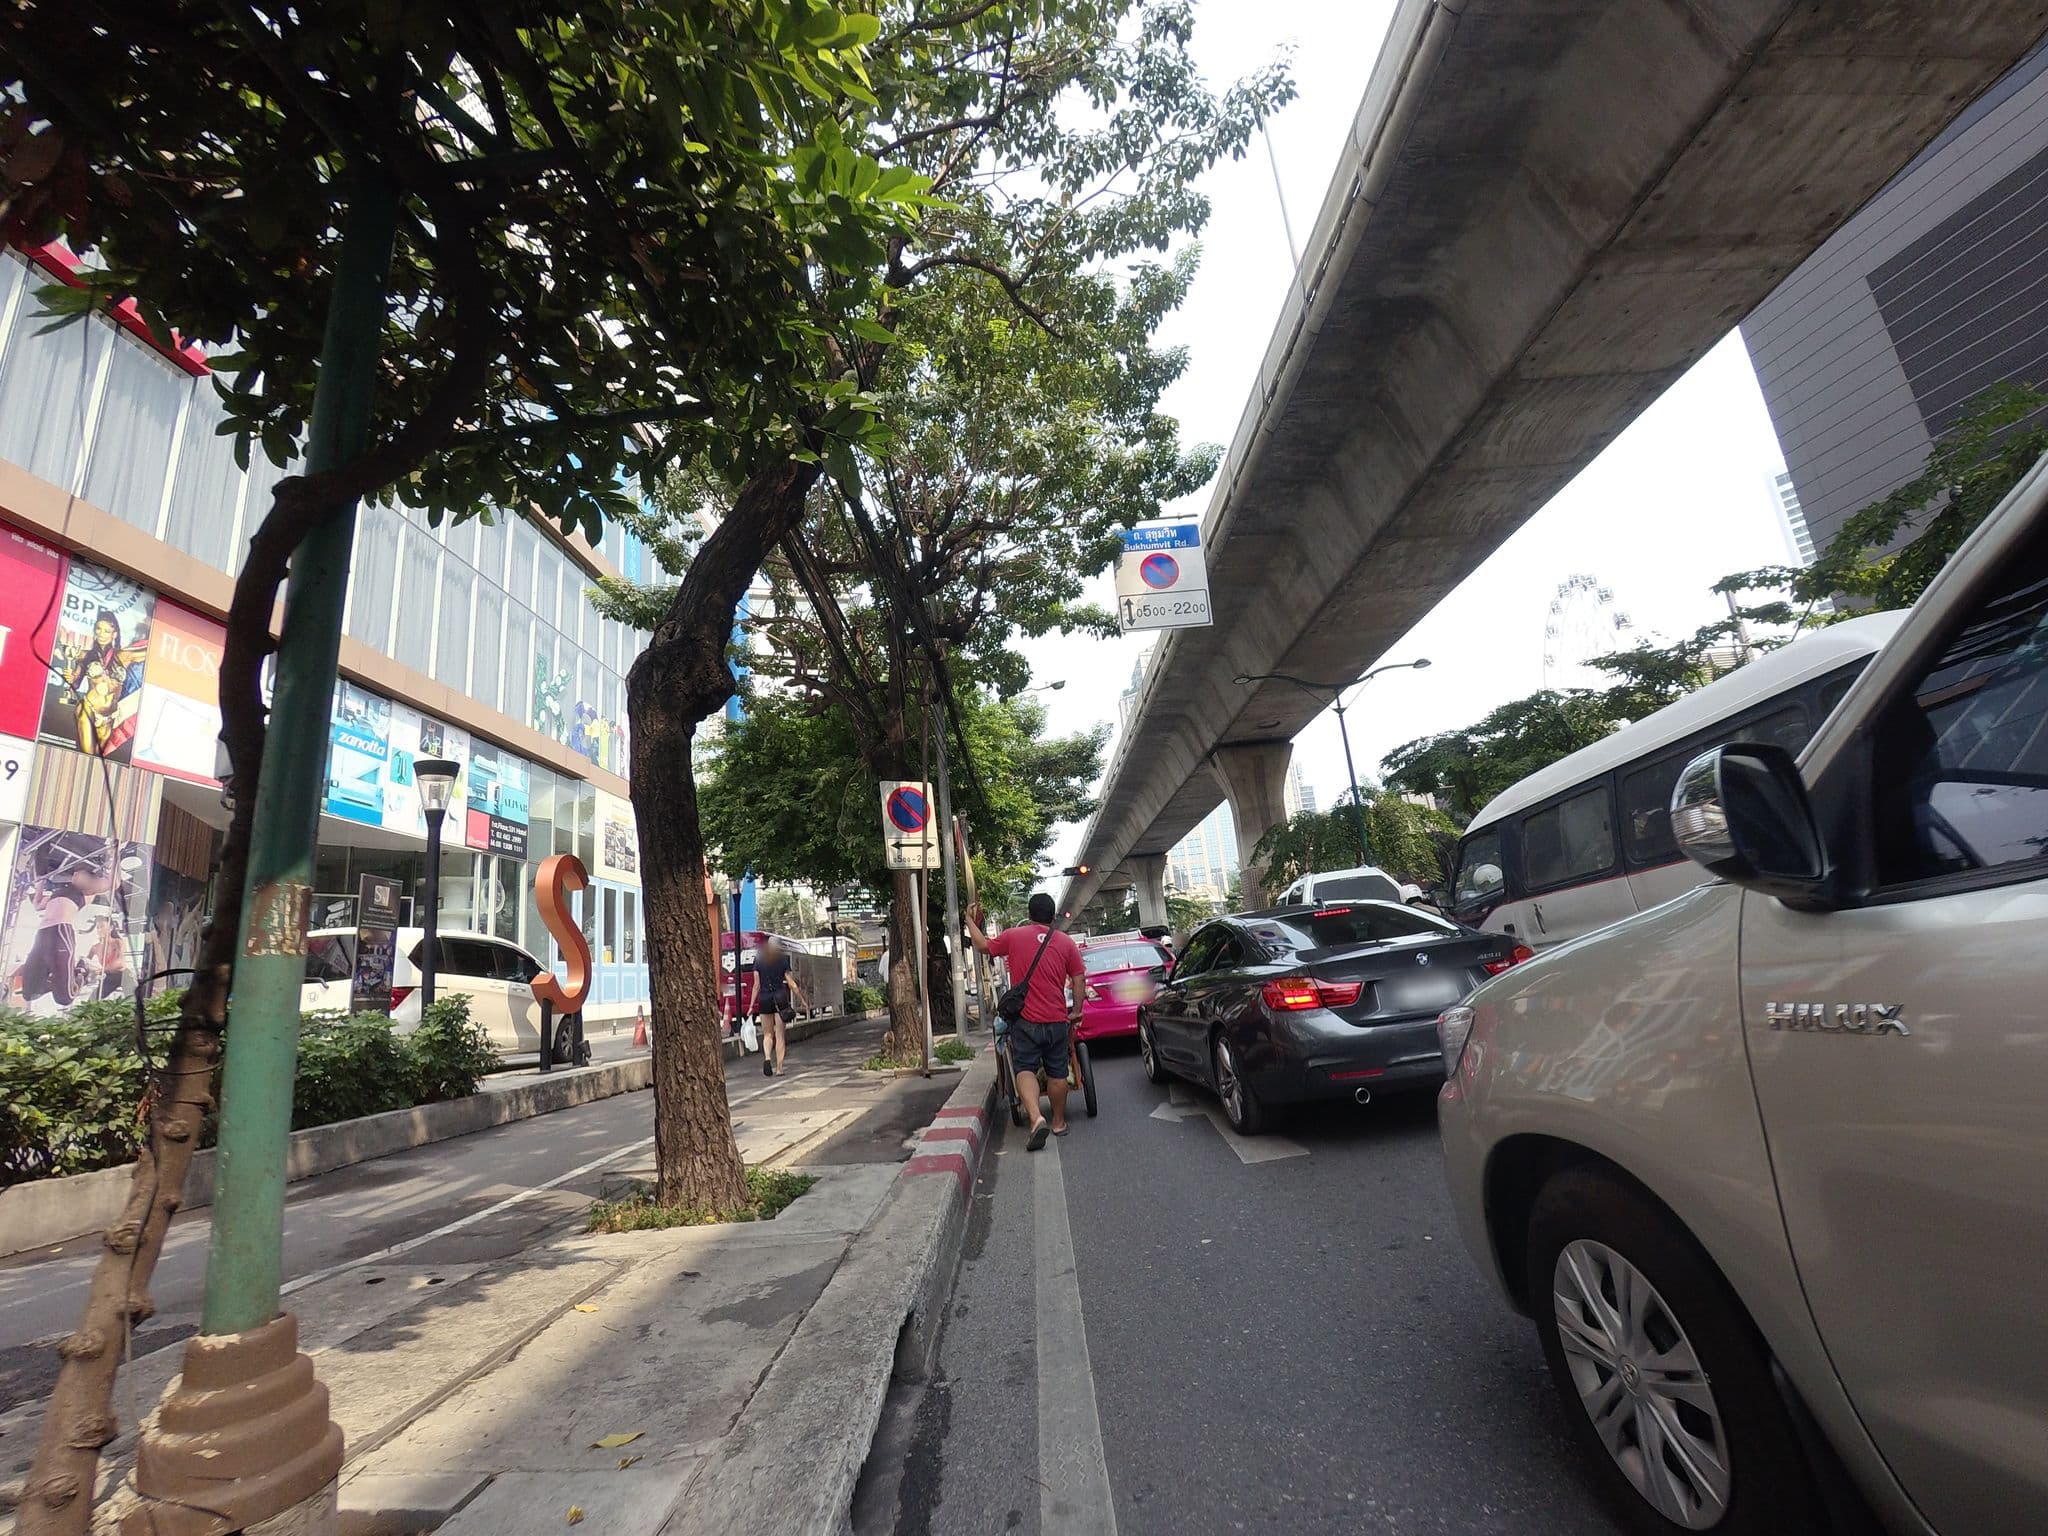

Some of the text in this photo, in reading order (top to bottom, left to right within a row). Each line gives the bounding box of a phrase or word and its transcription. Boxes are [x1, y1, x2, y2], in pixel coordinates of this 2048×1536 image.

[1123, 539, 1190, 552] Sukhumvit Rd.
[158, 631, 217, 677] FLOS
[337, 731, 386, 757] zanotta
[1765, 1002, 1911, 1037] HILUX
